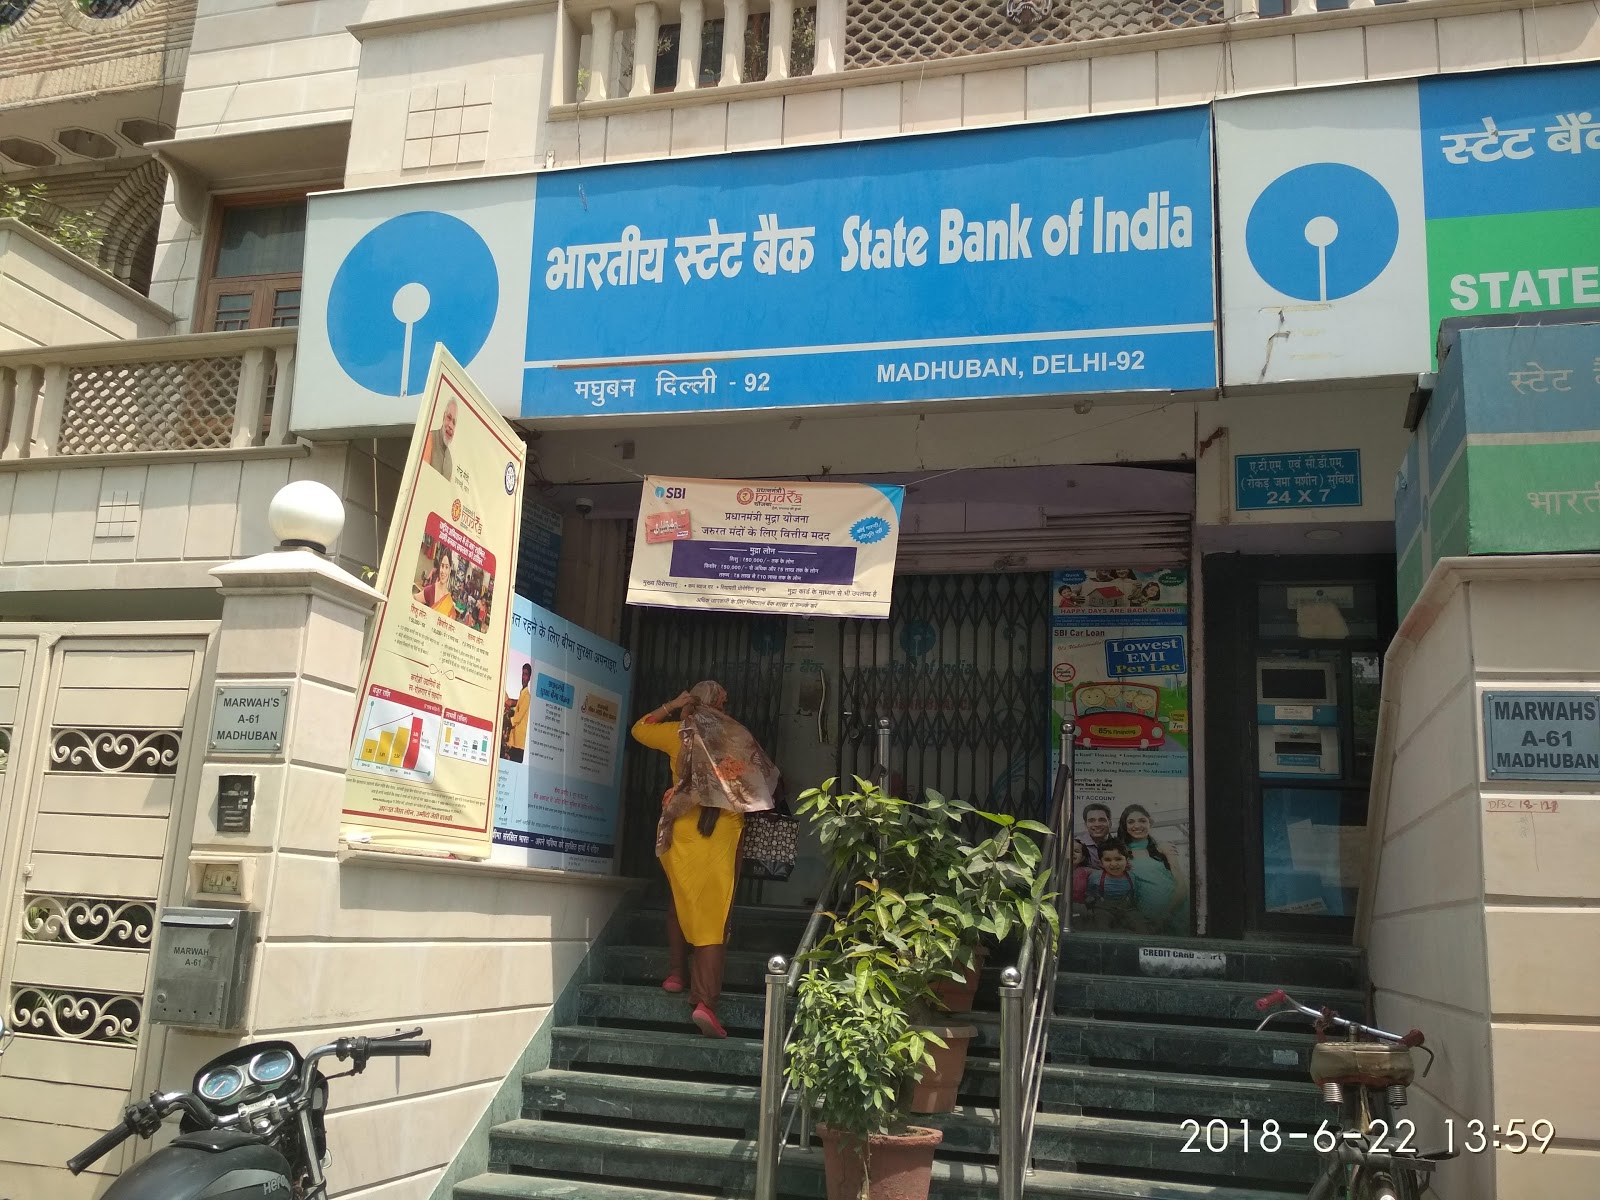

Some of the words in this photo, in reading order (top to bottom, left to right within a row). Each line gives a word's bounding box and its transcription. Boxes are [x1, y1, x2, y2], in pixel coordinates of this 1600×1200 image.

[1440, 116, 1536, 164] स्टेट
[841, 215, 929, 272] State
[939, 202, 1033, 265] Bank
[1042, 198, 1083, 257] of
[1093, 191, 1193, 254] India
[545, 224, 668, 291] भारतीय
[674, 218, 746, 285] स्टेट
[1450, 266, 1600, 311] STATE
[877, 356, 1024, 383] MADHUBAN,
[1032, 350, 1145, 375] DELHI-92
[655, 367, 717, 396] दिल्ली
[744, 372, 770, 393] 92
[1509, 362, 1574, 394] स्टेट
[1288, 456, 1301, 472] एवं
[1273, 477, 1290, 487] जमा
[1327, 471, 1355, 489] सुविधा
[665, 487, 686, 499] SBI
[1266, 490, 1291, 504] 24
[1297, 489, 1313, 503] X
[1319, 489, 1331, 502] 7
[725, 511, 762, 521] प्रधानमंत्री
[764, 514, 780, 525] मुद्रा
[782, 512, 809, 523] योजना
[747, 525, 757, 537] के
[759, 526, 777, 540] लिए
[780, 527, 808, 539] वित्तीय
[811, 531, 831, 541] मदद
[750, 547, 761, 556] मुद्रा
[762, 546, 776, 554] लोन
[798, 587, 811, 595] कार्ड
[522, 616, 538, 635] रहने
[538, 620, 546, 639] के
[547, 625, 561, 648] लिए
[561, 632, 576, 653] बीमा
[576, 643, 594, 660] सुरक्षा
[1054, 629, 1067, 637] SBI
[1085, 629, 1105, 637] Loan
[1112, 639, 1179, 653] Lowest
[1126, 651, 1166, 664] EMI
[1116, 663, 1145, 674] Per
[1150, 663, 1180, 672] Lac
[223, 697, 280, 707] MARWAH'S
[237, 714, 260, 723] A-61
[1494, 701, 1597, 721] MARWAHS
[216, 730, 278, 740] MADHUBAN
[1521, 730, 1573, 747] A-61
[1496, 752, 1599, 769] MADHUBAN
[173, 946, 209, 956] MARWAH
[1143, 949, 1171, 958] CREDIT
[184, 958, 202, 967] A-61
[263, 1174, 287, 1196] Hero
